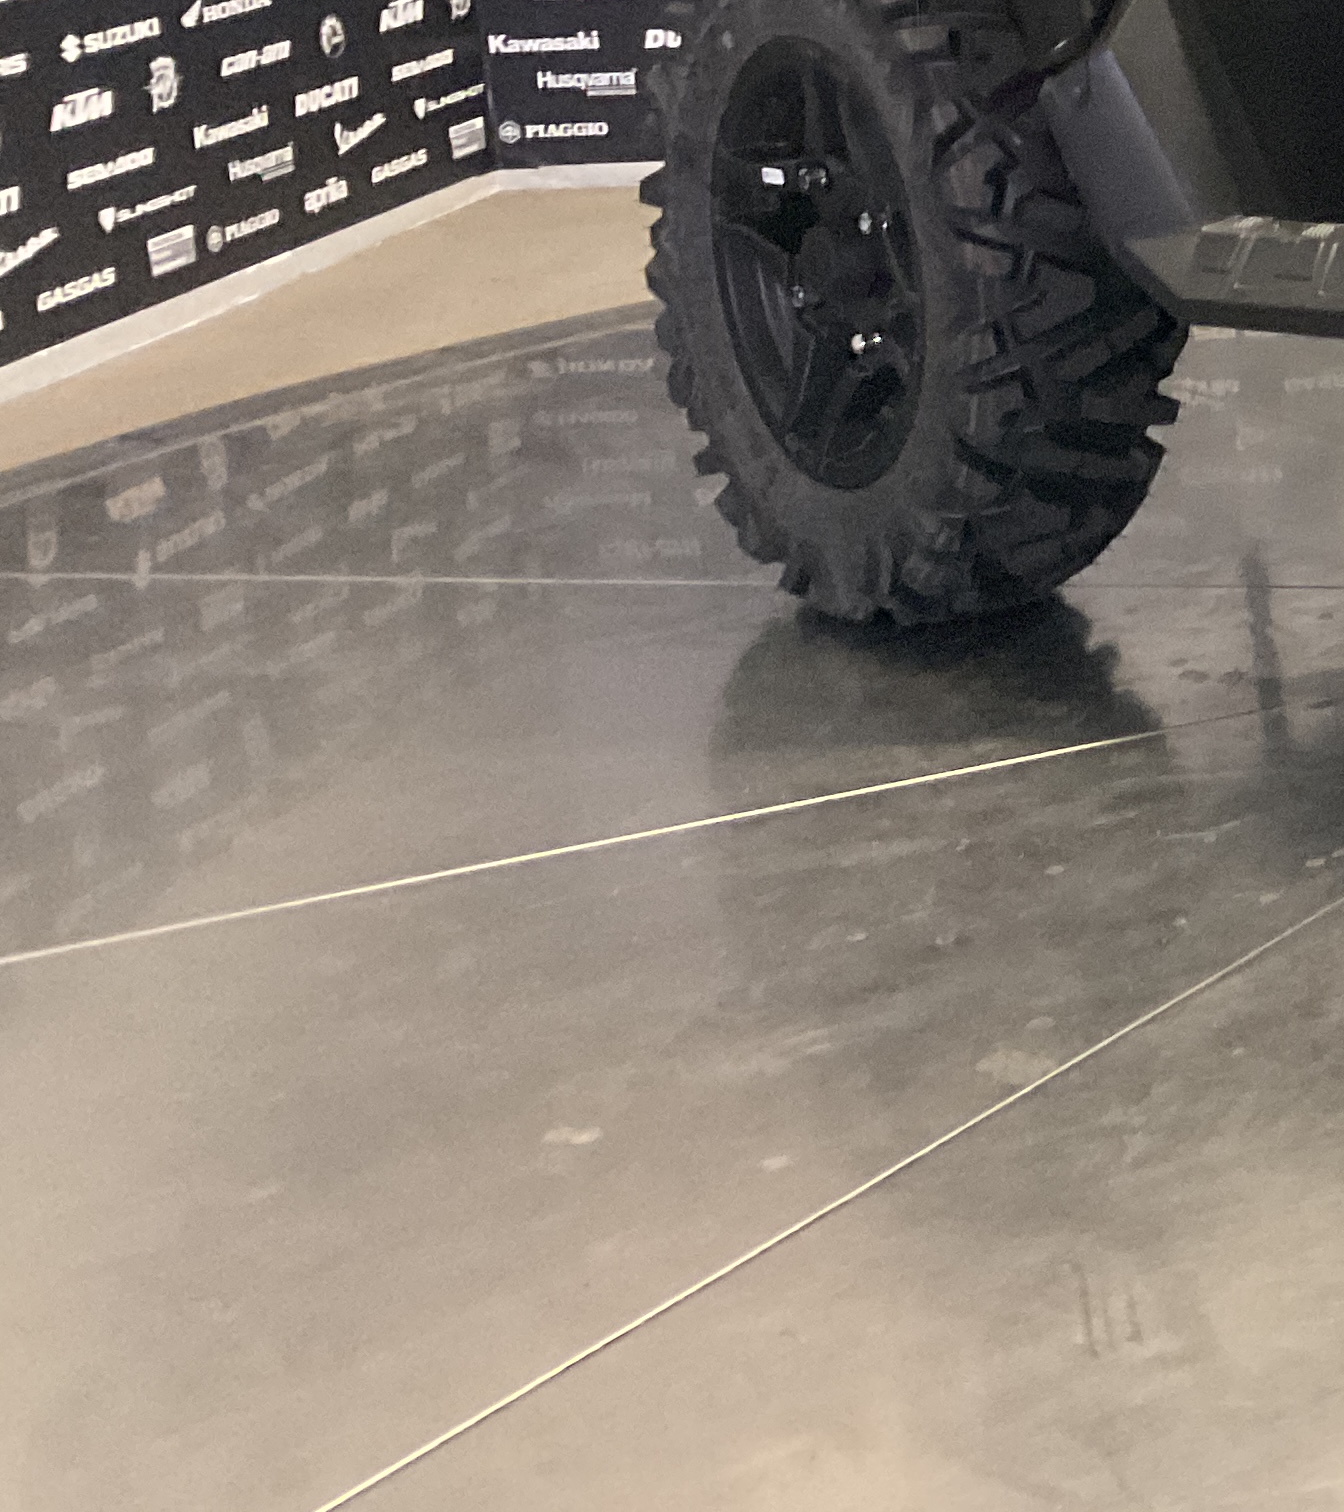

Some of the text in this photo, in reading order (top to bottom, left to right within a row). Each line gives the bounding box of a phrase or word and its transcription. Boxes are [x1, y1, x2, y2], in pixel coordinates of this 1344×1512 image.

[83, 17, 161, 53] SUZUKI
[488, 30, 600, 54] Kawasaki
[525, 122, 609, 138] PIAGGIO
[37, 267, 116, 312] GASGAS
